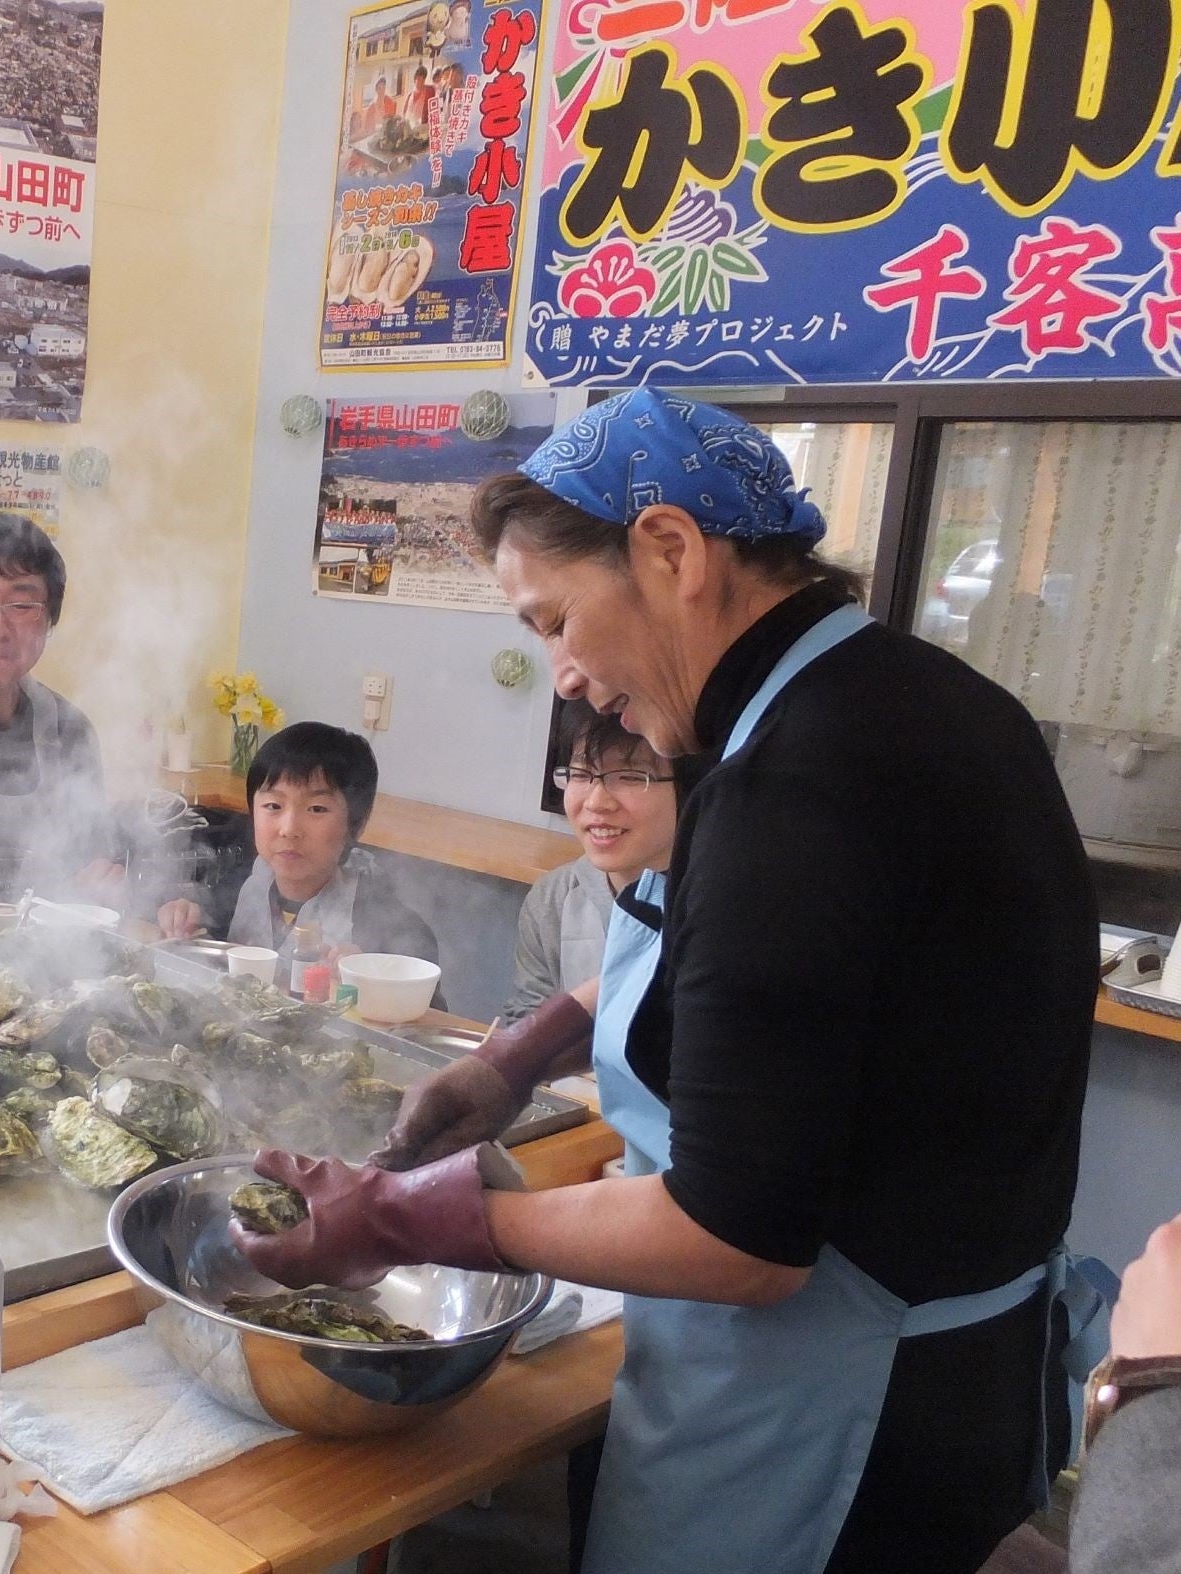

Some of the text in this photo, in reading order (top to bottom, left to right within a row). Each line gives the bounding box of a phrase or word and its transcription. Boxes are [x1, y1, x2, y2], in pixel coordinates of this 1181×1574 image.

[457, 75, 478, 143] 殻付きカキ
[459, 7, 537, 274] かき小屋
[560, 0, 1181, 246] かき小
[550, 312, 848, 351] 贈 やまだ夢プロジェクト
[339, 403, 460, 431] 岩手県山田町
